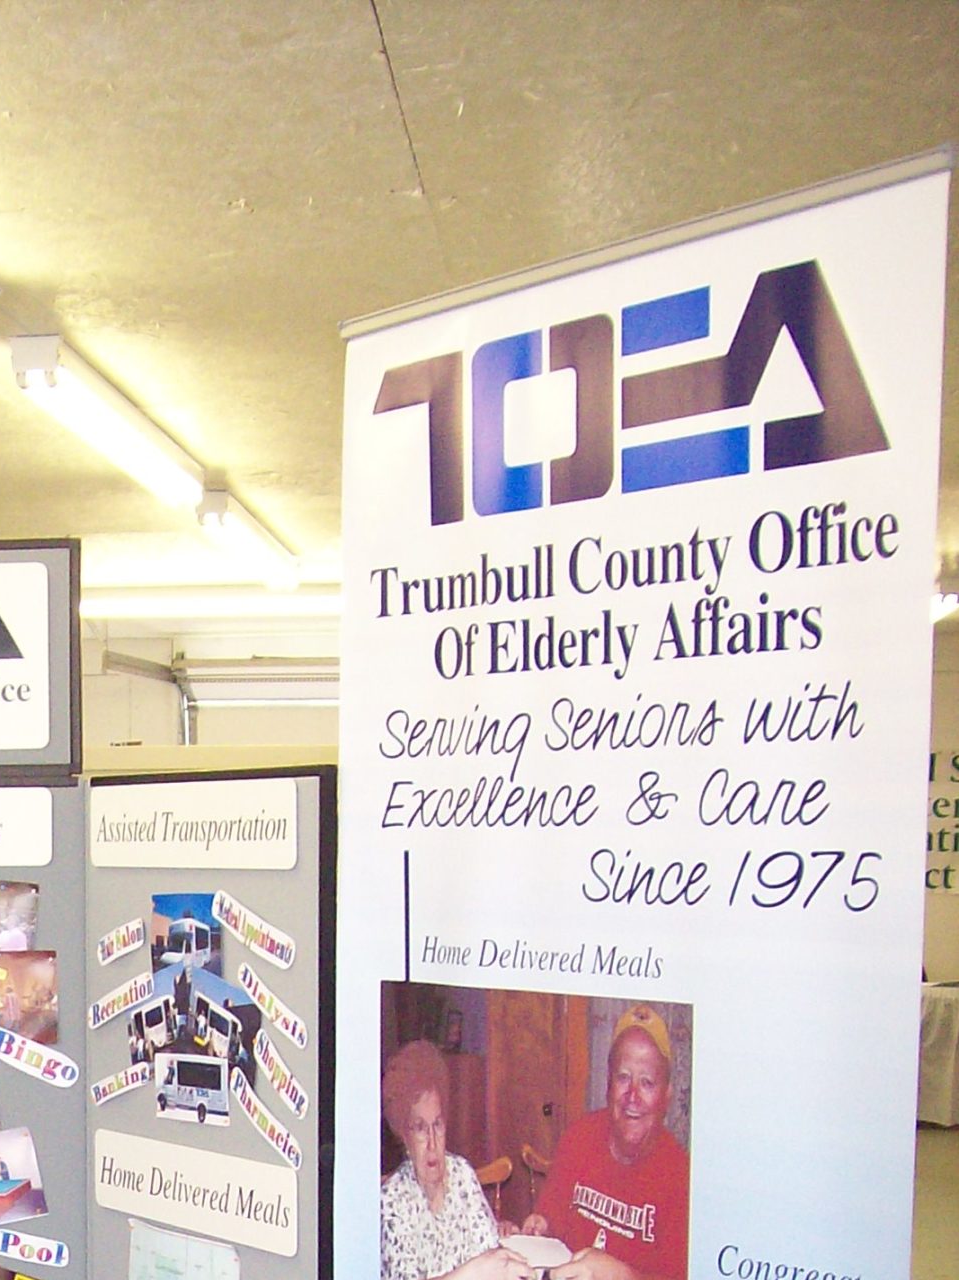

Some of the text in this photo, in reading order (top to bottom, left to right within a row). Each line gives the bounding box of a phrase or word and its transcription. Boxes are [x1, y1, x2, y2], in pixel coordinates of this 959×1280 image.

[370, 502, 900, 618] Trumbull County Office
[433, 592, 823, 680] Of Elderly Affairs
[379, 680, 865, 786] Serving Seniors with
[97, 808, 288, 851] Assisted Transportation
[382, 769, 831, 831] Excellence & Care
[581, 847, 884, 913] Since 1975
[115, 920, 144, 950] Salon
[421, 935, 664, 980] Home Delivered Meals
[91, 976, 154, 1027] Recreation
[241, 964, 306, 1048] Dialysis
[93, 1066, 149, 1105] Banking
[255, 1030, 305, 1116] Shopping
[232, 1068, 302, 1168] Pharmacies
[100, 1155, 291, 1229] Home Delivered Meals
